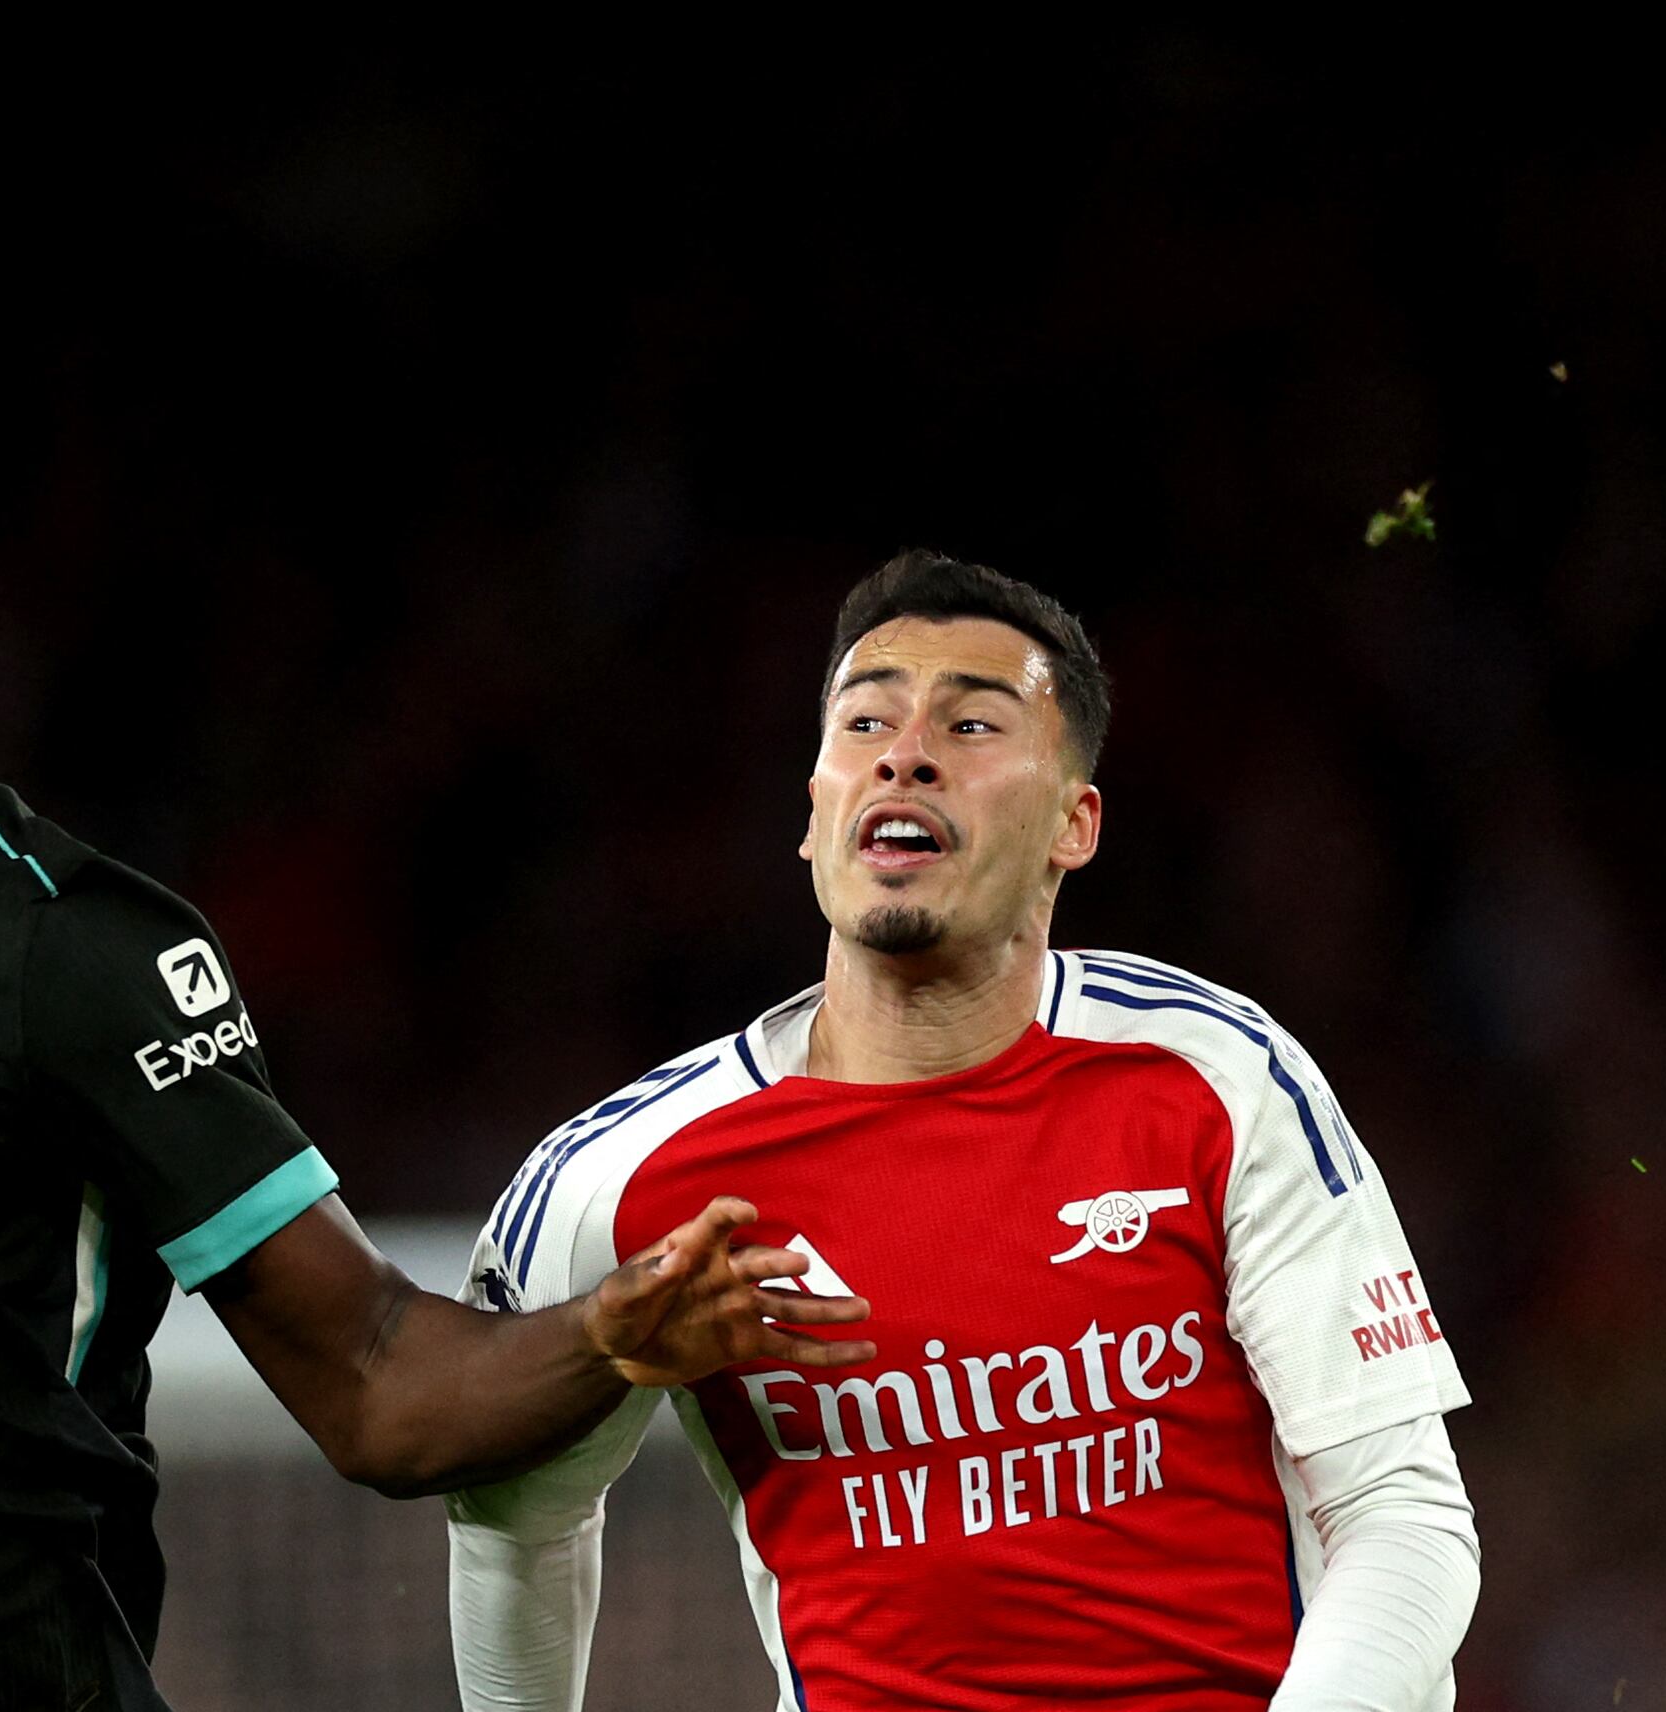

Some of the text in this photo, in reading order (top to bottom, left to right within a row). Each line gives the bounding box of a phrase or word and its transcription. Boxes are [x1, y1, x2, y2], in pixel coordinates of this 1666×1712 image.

[738, 1311, 1203, 1461] Emirates
[841, 1417, 1163, 1548] FLY BETTER
